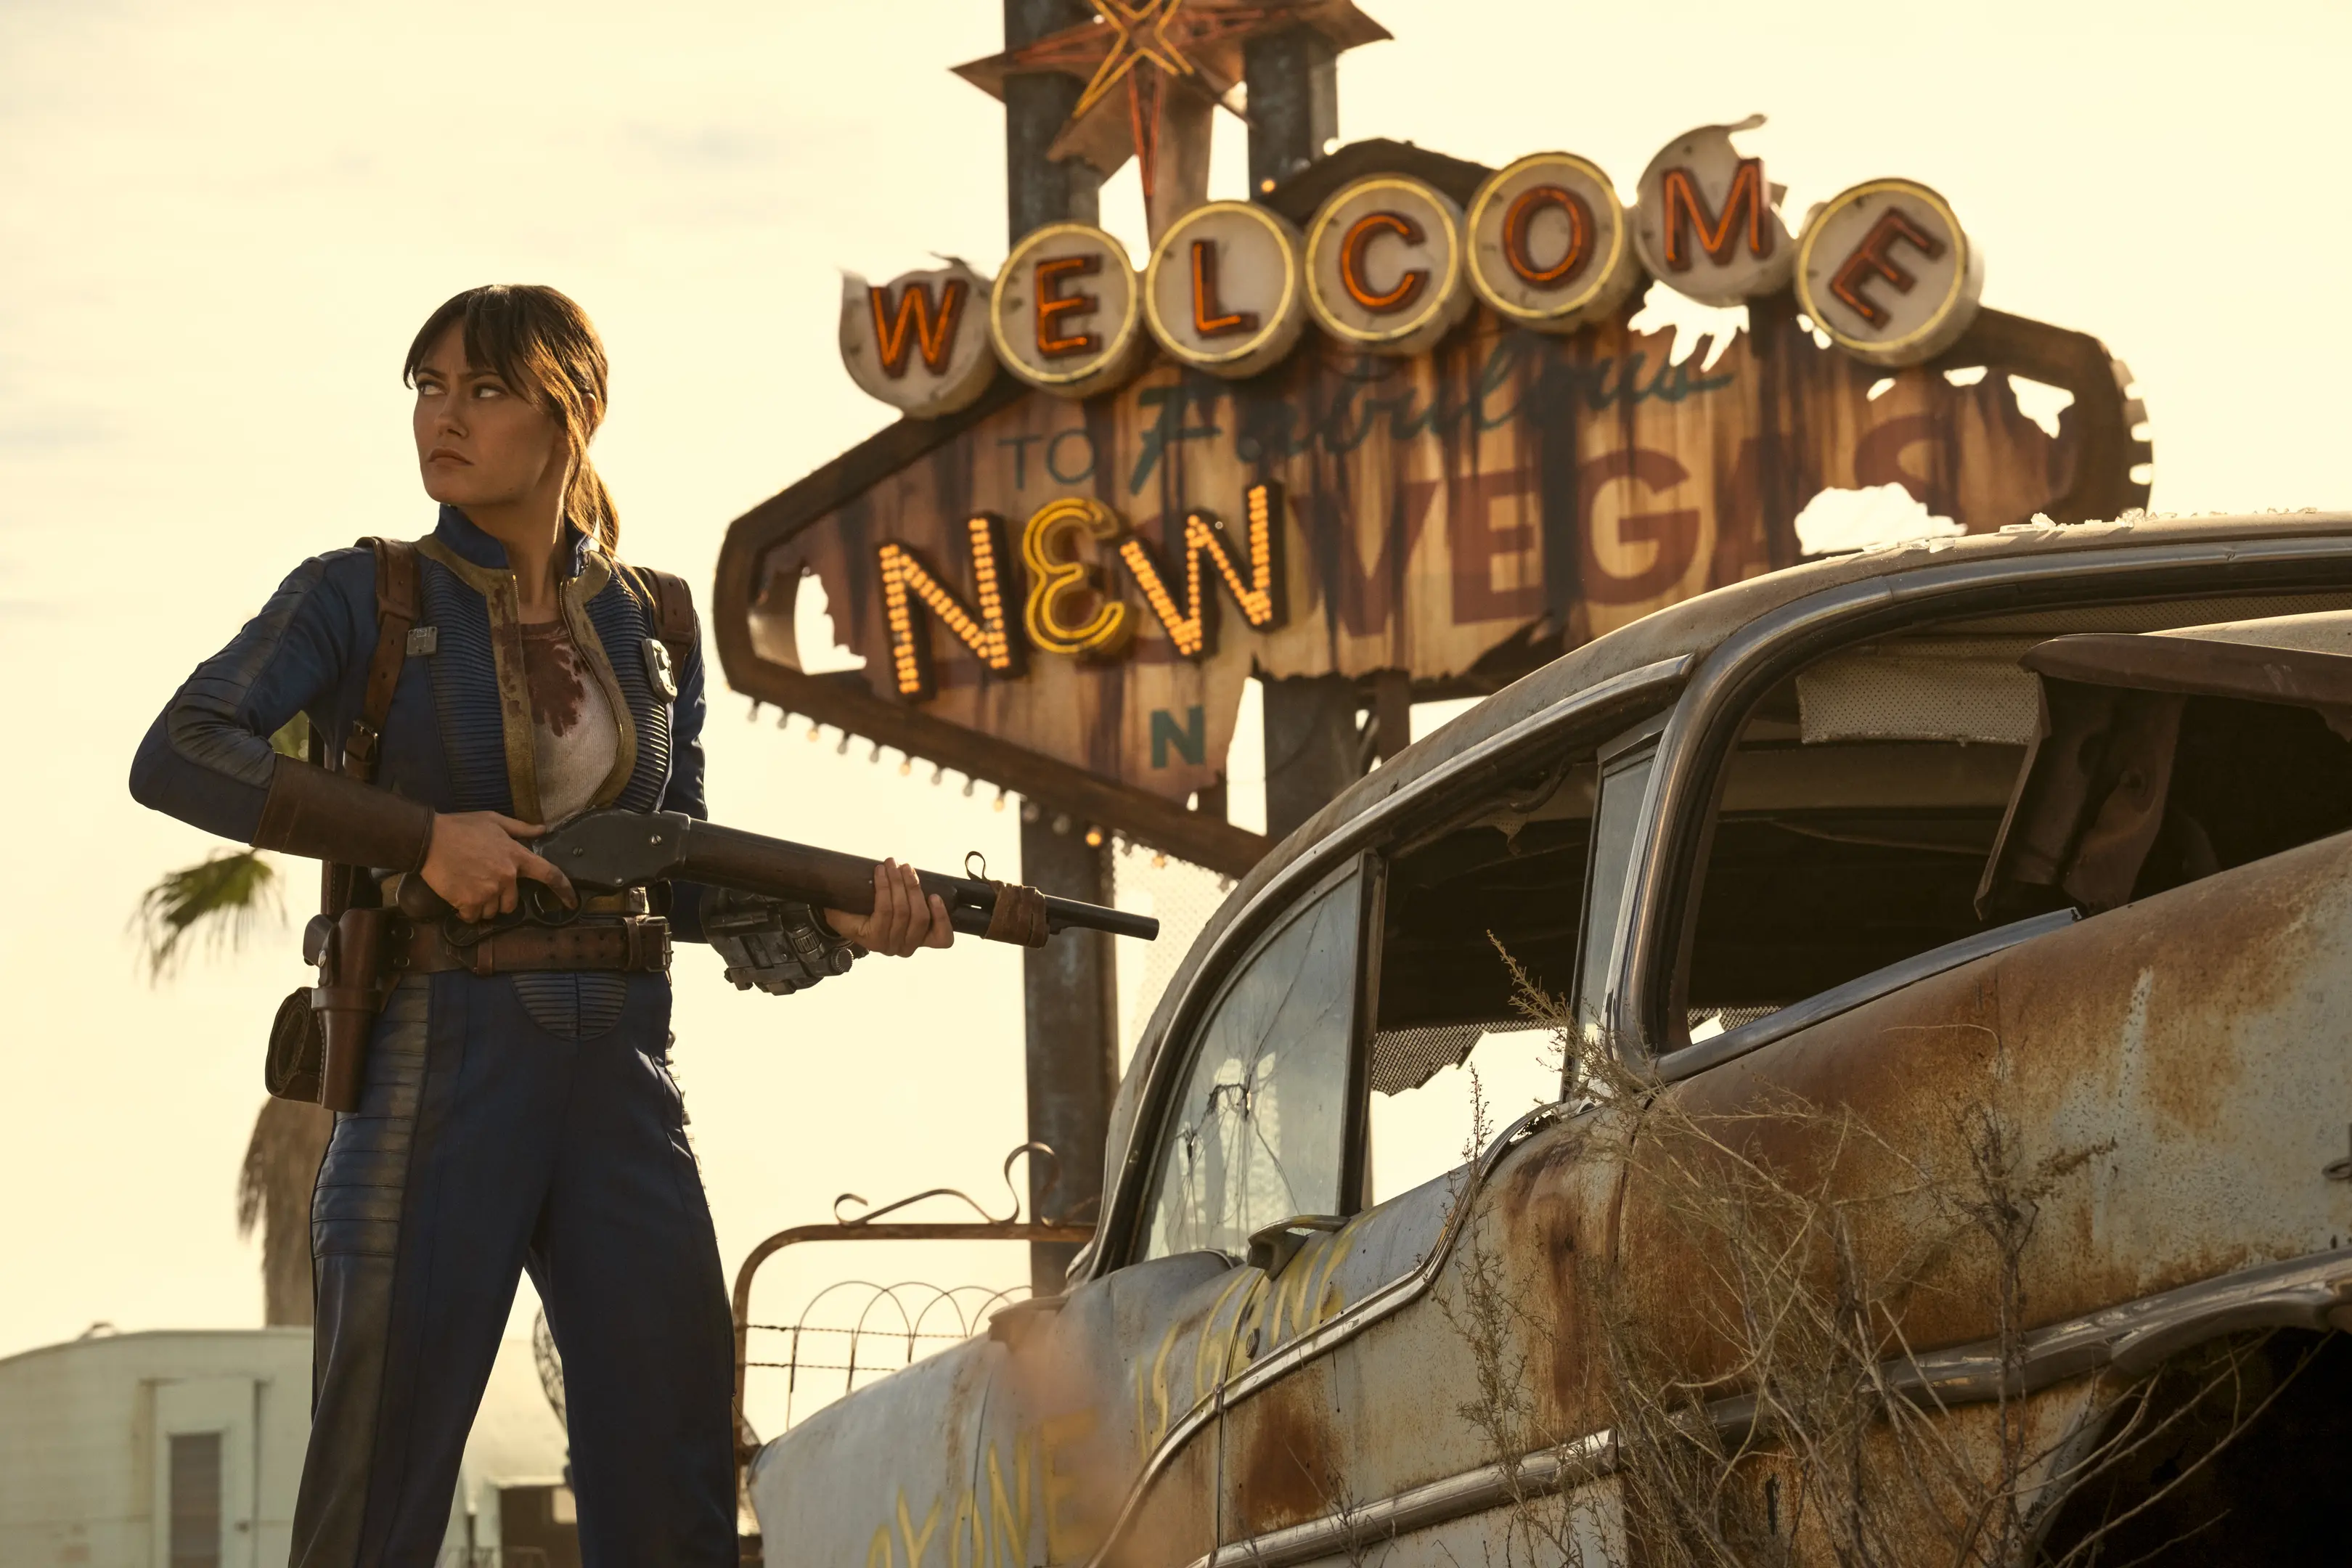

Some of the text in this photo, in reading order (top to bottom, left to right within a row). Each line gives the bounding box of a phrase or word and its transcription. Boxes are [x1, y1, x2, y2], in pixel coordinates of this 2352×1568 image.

[869, 156, 1947, 379] WELCOME
[997, 427, 1096, 491] TO
[876, 479, 1286, 698] NEW
